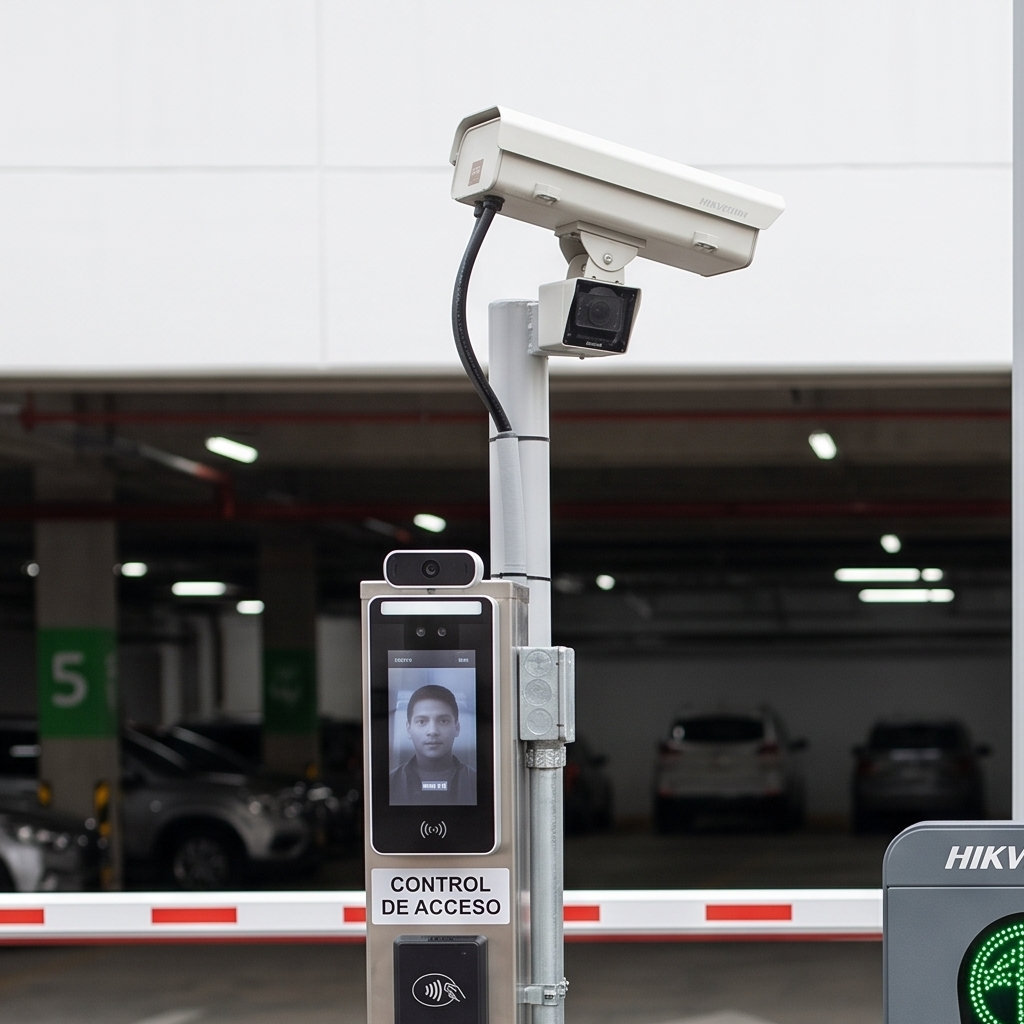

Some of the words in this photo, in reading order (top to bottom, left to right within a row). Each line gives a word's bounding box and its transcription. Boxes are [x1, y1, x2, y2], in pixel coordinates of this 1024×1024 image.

[51, 650, 89, 709] 5
[390, 876, 491, 893] CONTROL
[381, 899, 409, 915] DE
[414, 898, 501, 915] ACCESO
